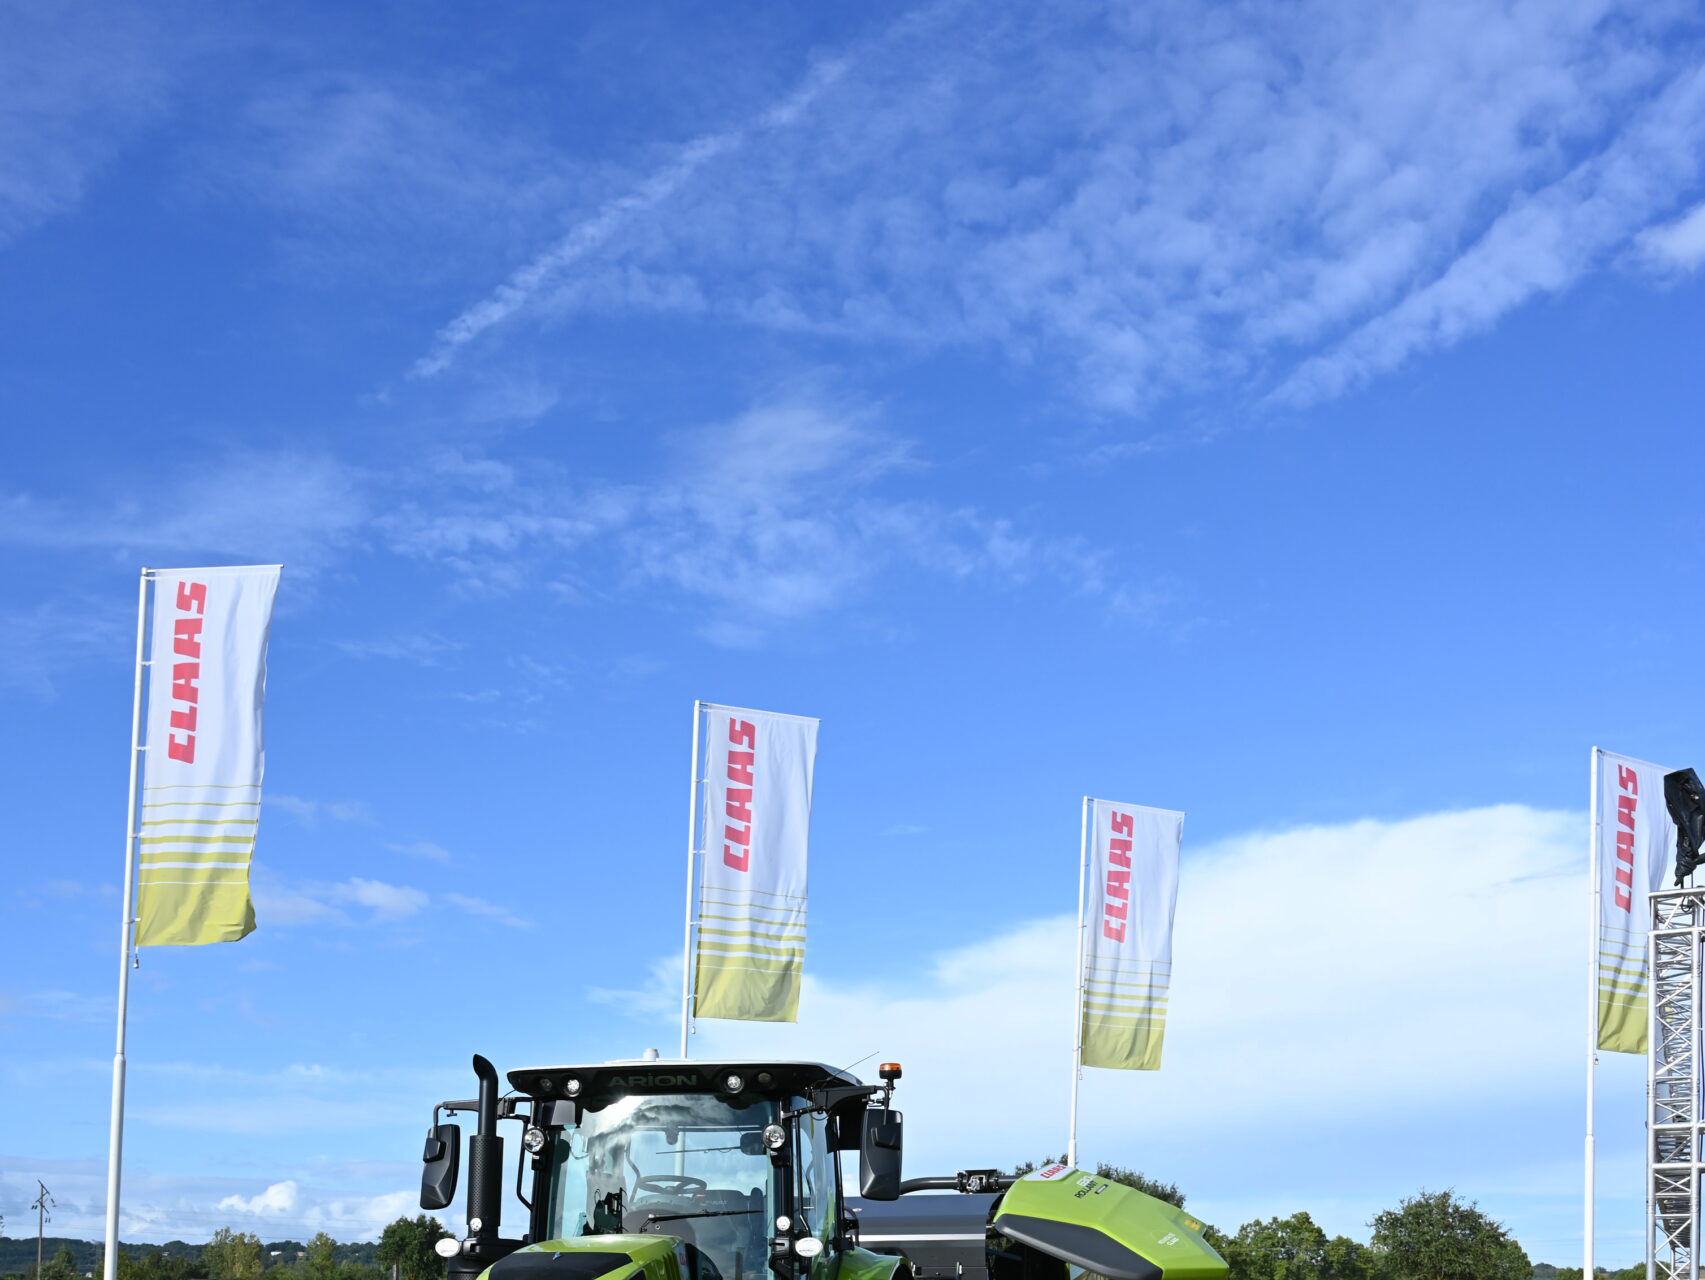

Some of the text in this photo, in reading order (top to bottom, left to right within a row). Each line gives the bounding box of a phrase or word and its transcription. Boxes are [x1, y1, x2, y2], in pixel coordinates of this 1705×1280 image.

[168, 580, 207, 764] CLAAS
[723, 716, 756, 873] CLAAS
[1614, 763, 1639, 914] CLAAS
[1103, 810, 1134, 944] CLAAS
